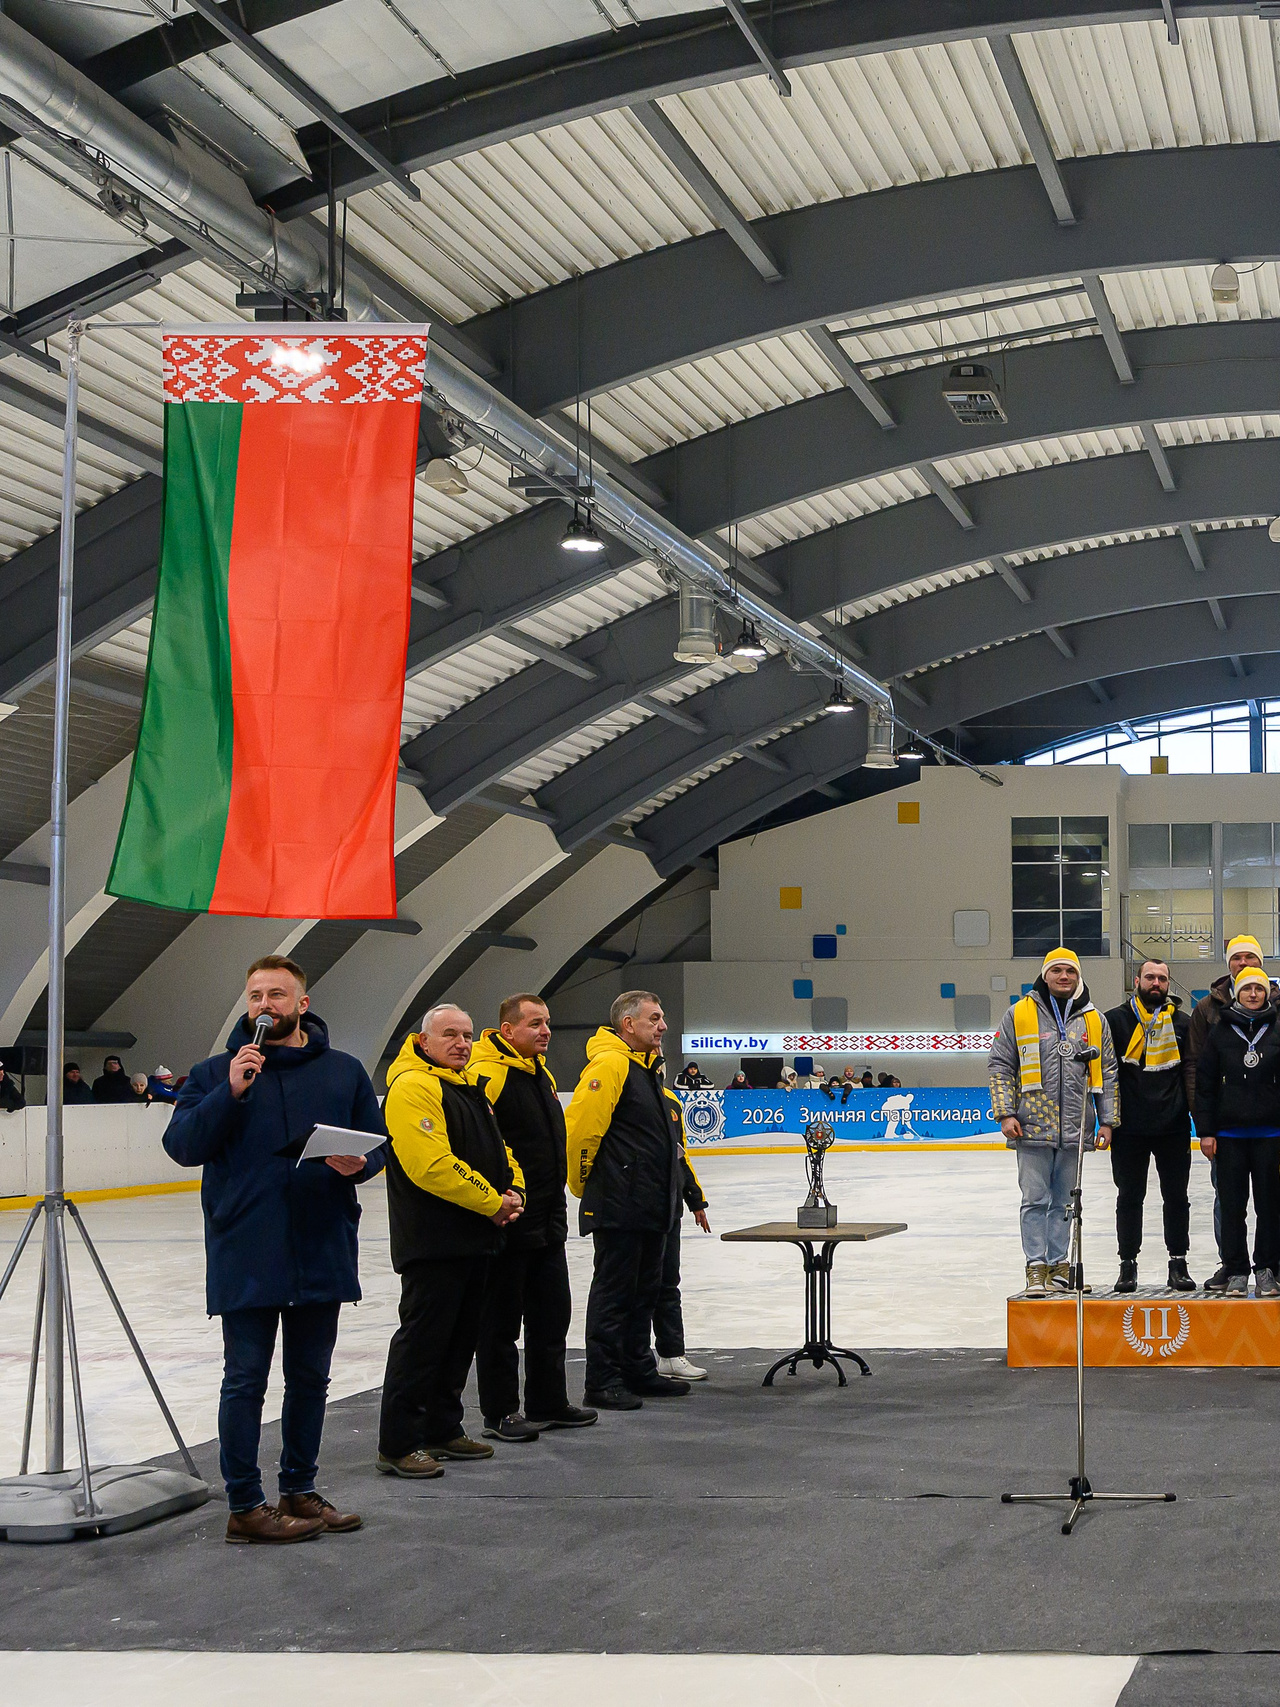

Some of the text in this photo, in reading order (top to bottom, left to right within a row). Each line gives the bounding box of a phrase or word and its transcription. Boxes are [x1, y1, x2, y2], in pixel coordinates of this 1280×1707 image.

[690, 1036, 769, 1050] silichy.by
[742, 1107, 785, 1124] 2026
[799, 1107, 867, 1124] Зимняя
[870, 1108, 982, 1126] спартакиада
[452, 1162, 490, 1195] BELARUS
[579, 1148, 588, 1184] BELARUS
[1140, 1307, 1172, 1340] II
